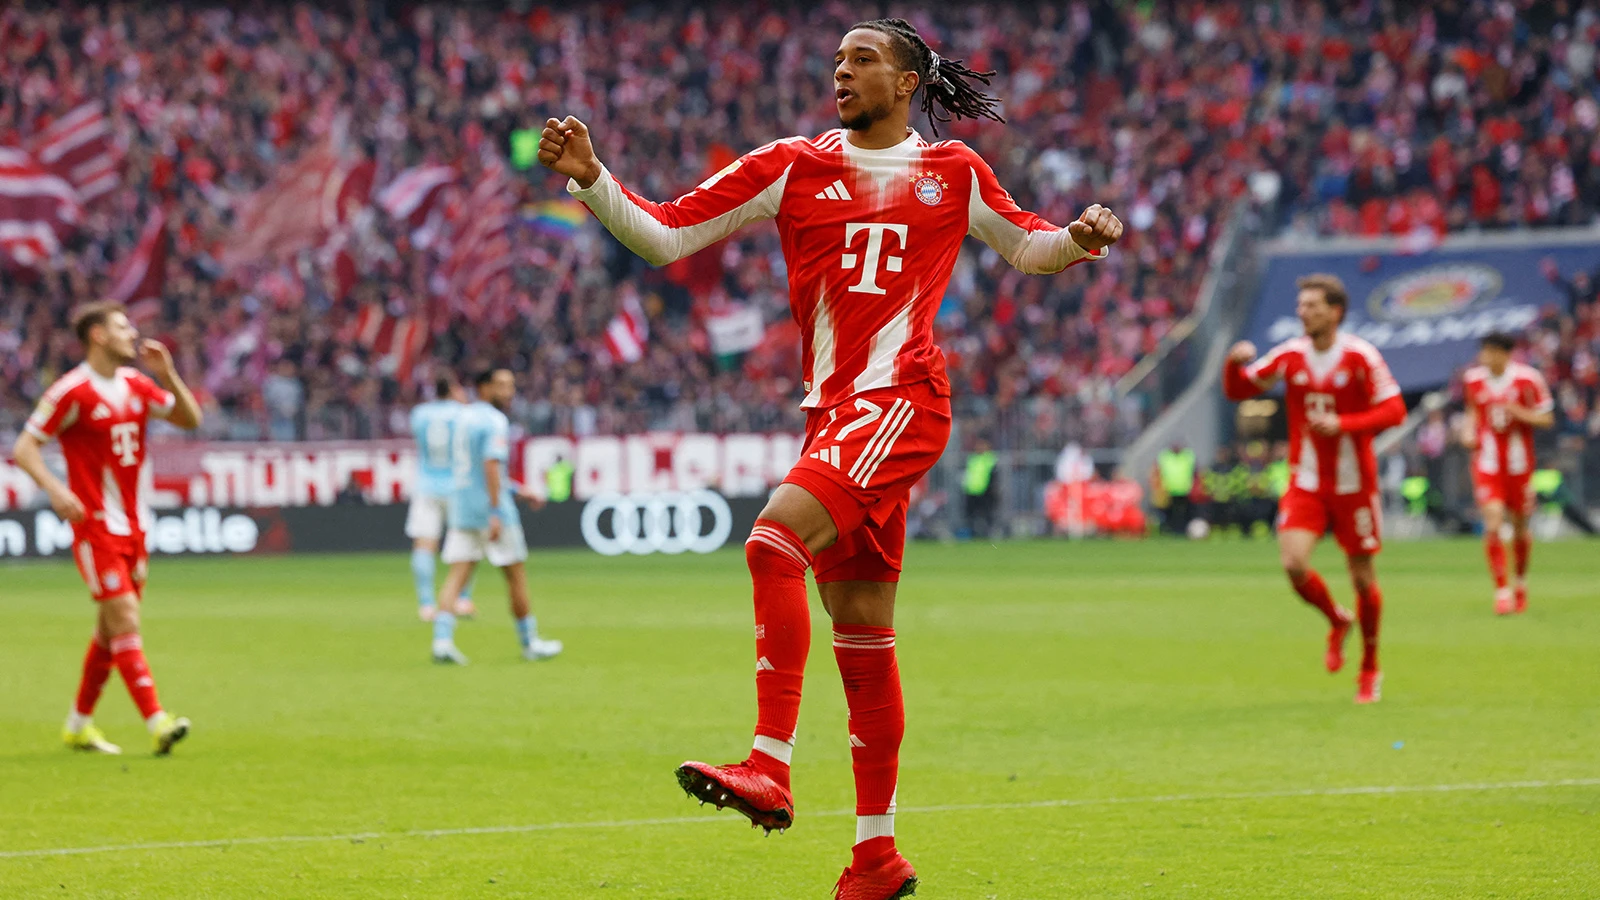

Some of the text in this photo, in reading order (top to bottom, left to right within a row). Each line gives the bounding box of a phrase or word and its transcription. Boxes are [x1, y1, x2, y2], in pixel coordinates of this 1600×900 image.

[841, 222, 908, 295] T
[110, 421, 140, 467] T
[36, 509, 258, 554] Melle
